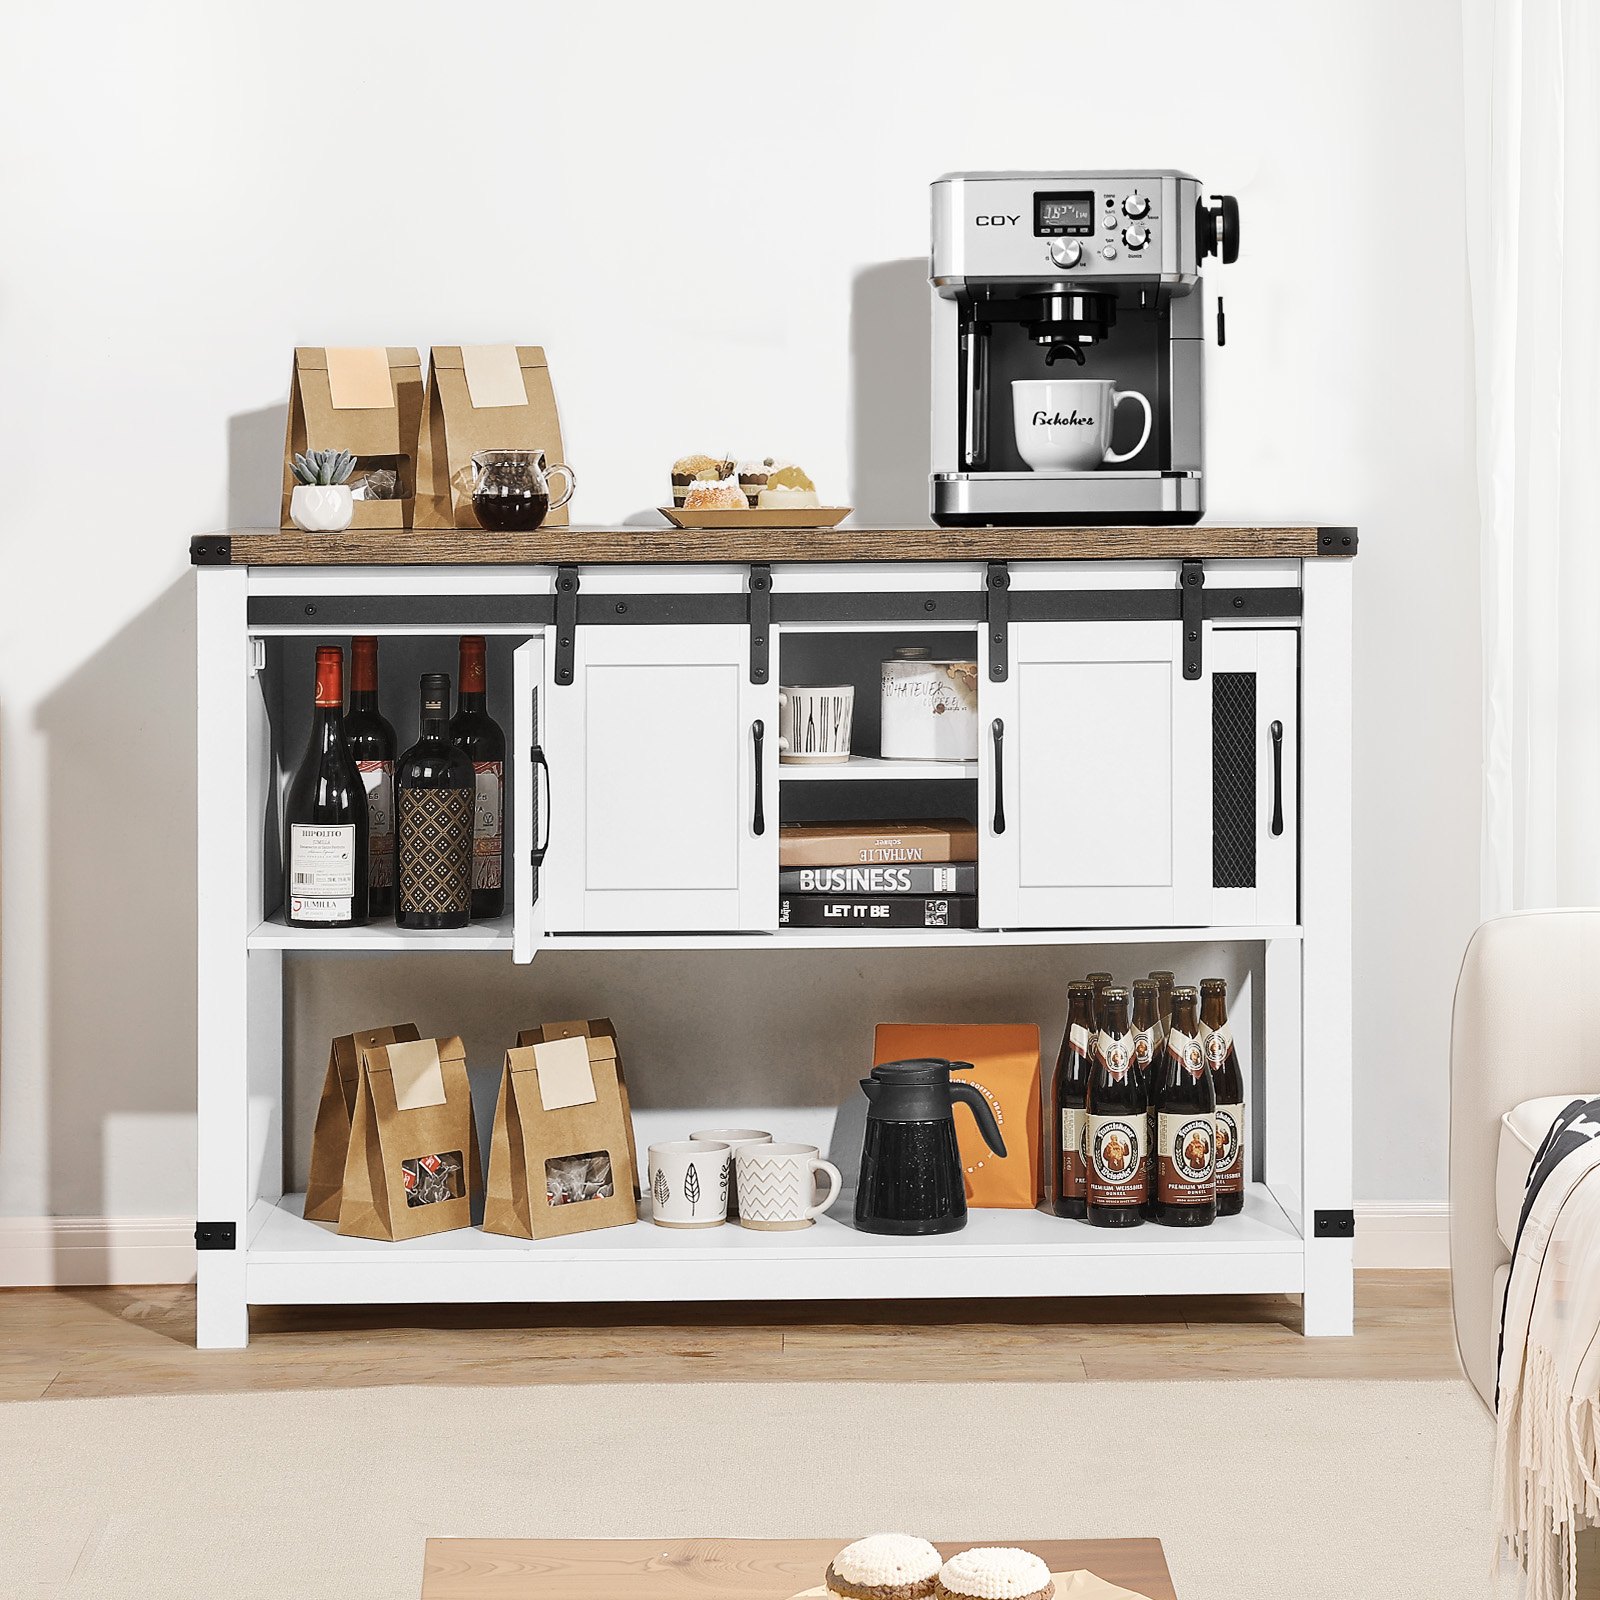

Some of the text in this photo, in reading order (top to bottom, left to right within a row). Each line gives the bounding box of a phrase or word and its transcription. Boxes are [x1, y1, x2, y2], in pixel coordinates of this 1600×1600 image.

[976, 215, 1021, 226] COY
[886, 681, 944, 697] WHATEVER
[859, 847, 923, 862] NATHALIE
[799, 867, 912, 892] BUSINESS
[304, 900, 337, 908] JUMILLA
[824, 904, 890, 918] LET IT BE
[970, 1081, 1004, 1125] COFFEE BEANS
